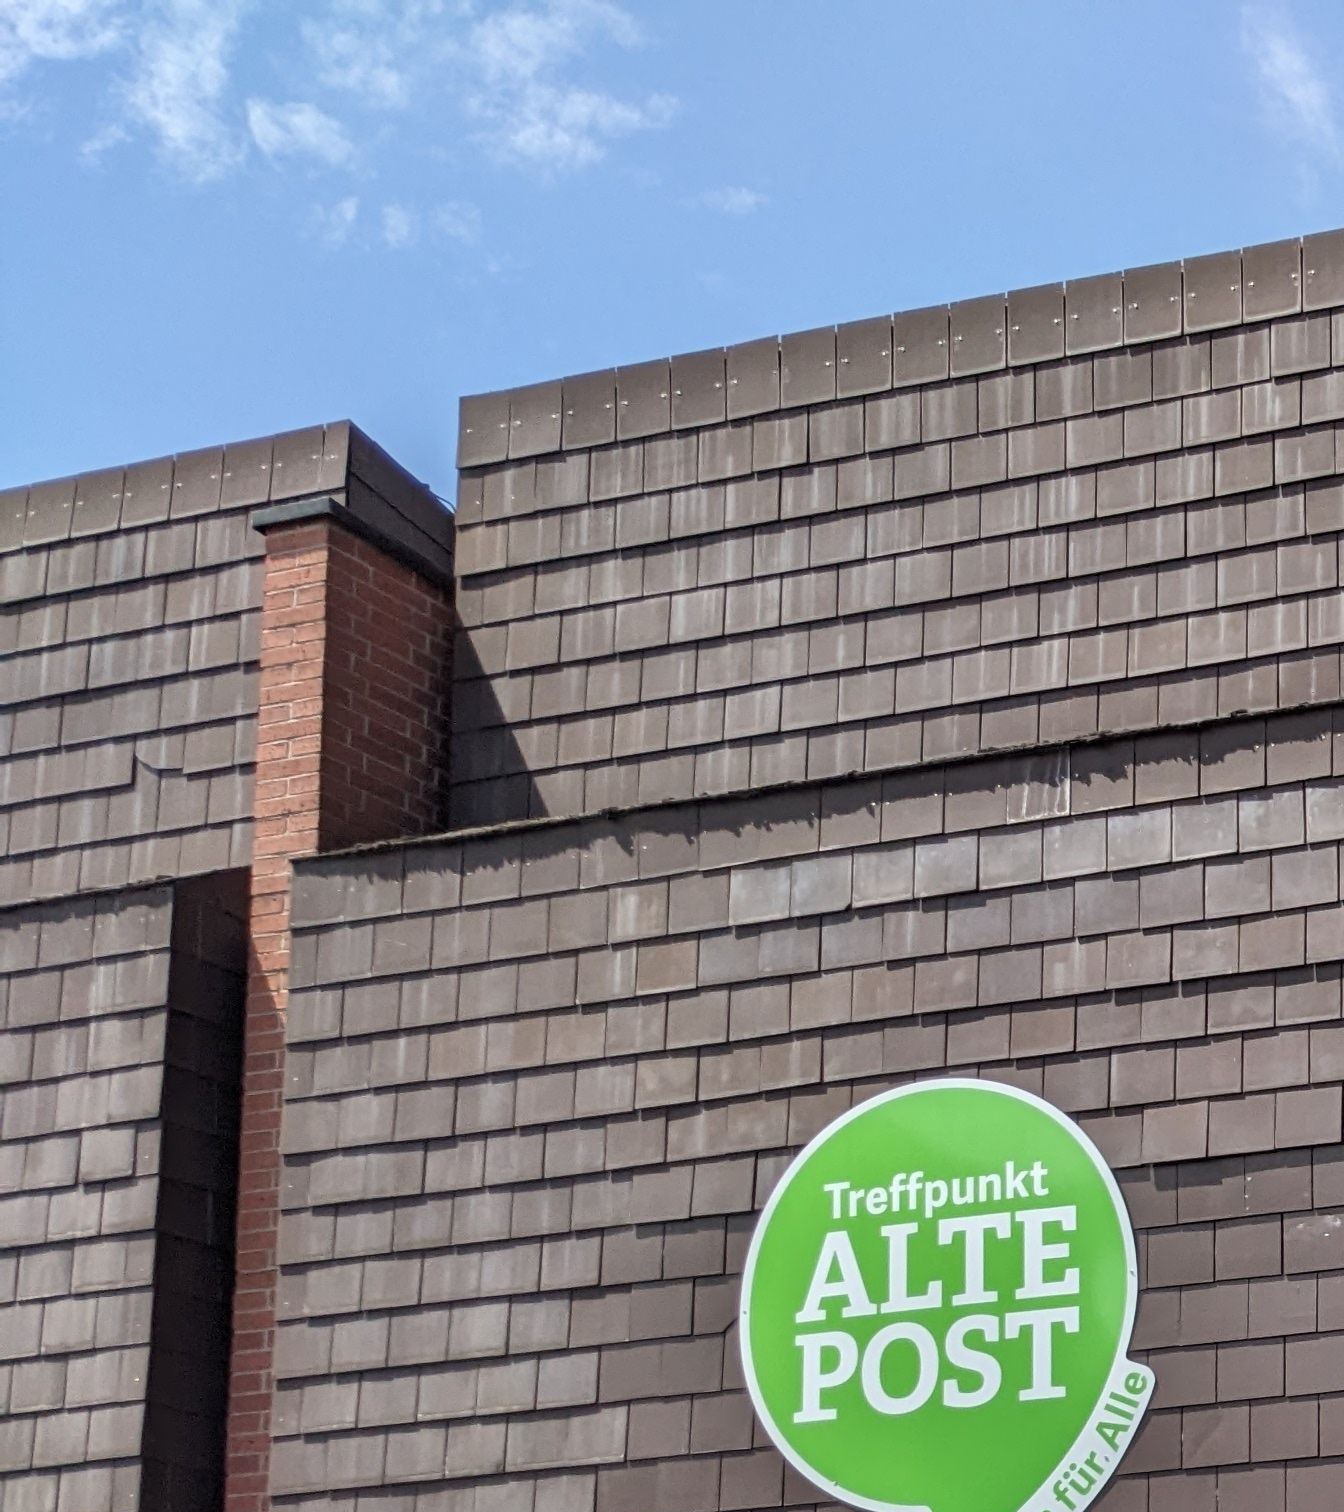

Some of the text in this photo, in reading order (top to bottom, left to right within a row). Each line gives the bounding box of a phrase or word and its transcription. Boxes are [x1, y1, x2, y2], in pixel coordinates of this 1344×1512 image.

[824, 1160, 1050, 1219] Treffpunkt
[795, 1204, 1081, 1324] ALTE
[792, 1305, 1081, 1424] POST
[1052, 1450, 1105, 1512] für
[1095, 1371, 1148, 1453] Alle
